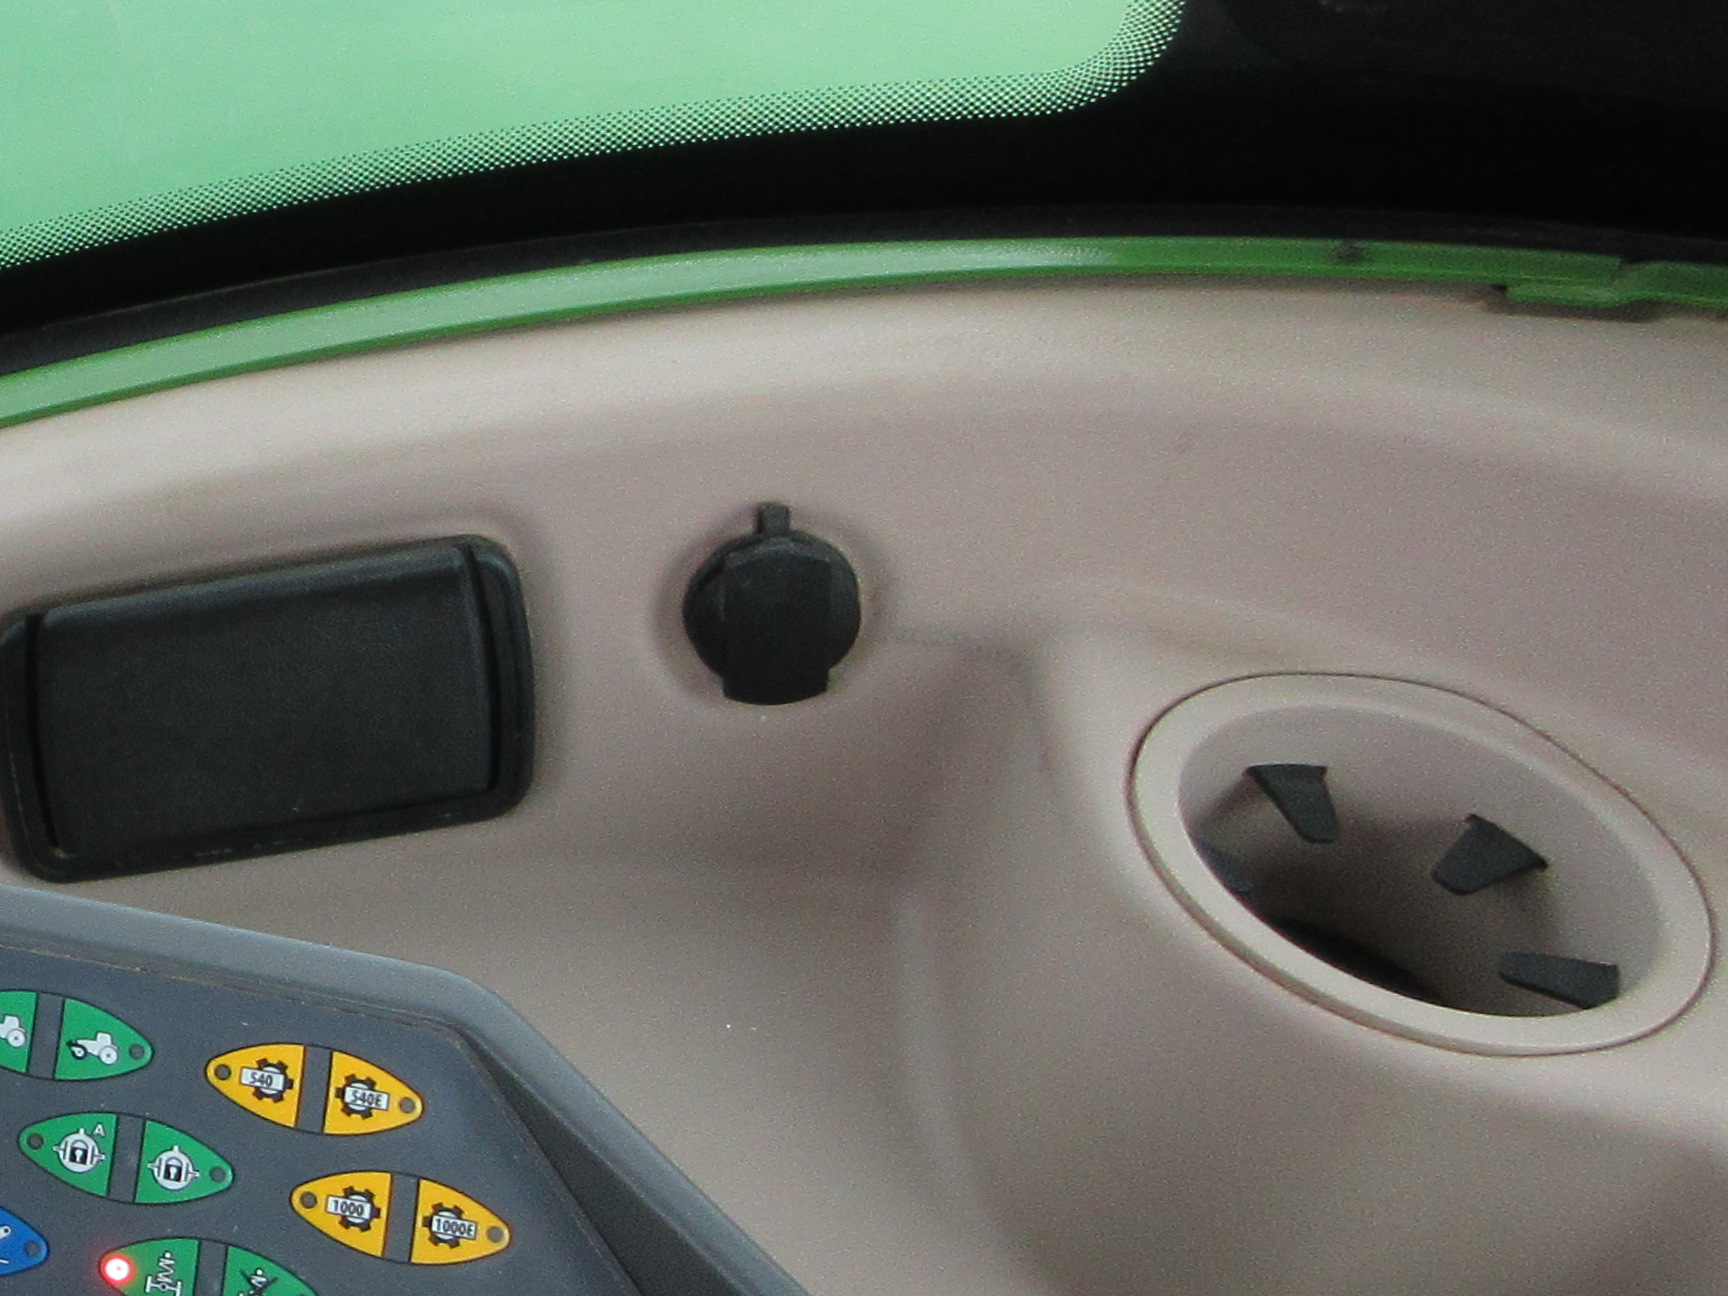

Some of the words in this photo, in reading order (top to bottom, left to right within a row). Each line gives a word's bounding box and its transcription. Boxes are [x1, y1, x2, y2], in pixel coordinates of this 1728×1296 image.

[249, 1072, 274, 1088] 540
[351, 1089, 383, 1107] 540E
[92, 1123, 107, 1138] A
[332, 1199, 365, 1216] 1000
[435, 1217, 476, 1237] 1000E
